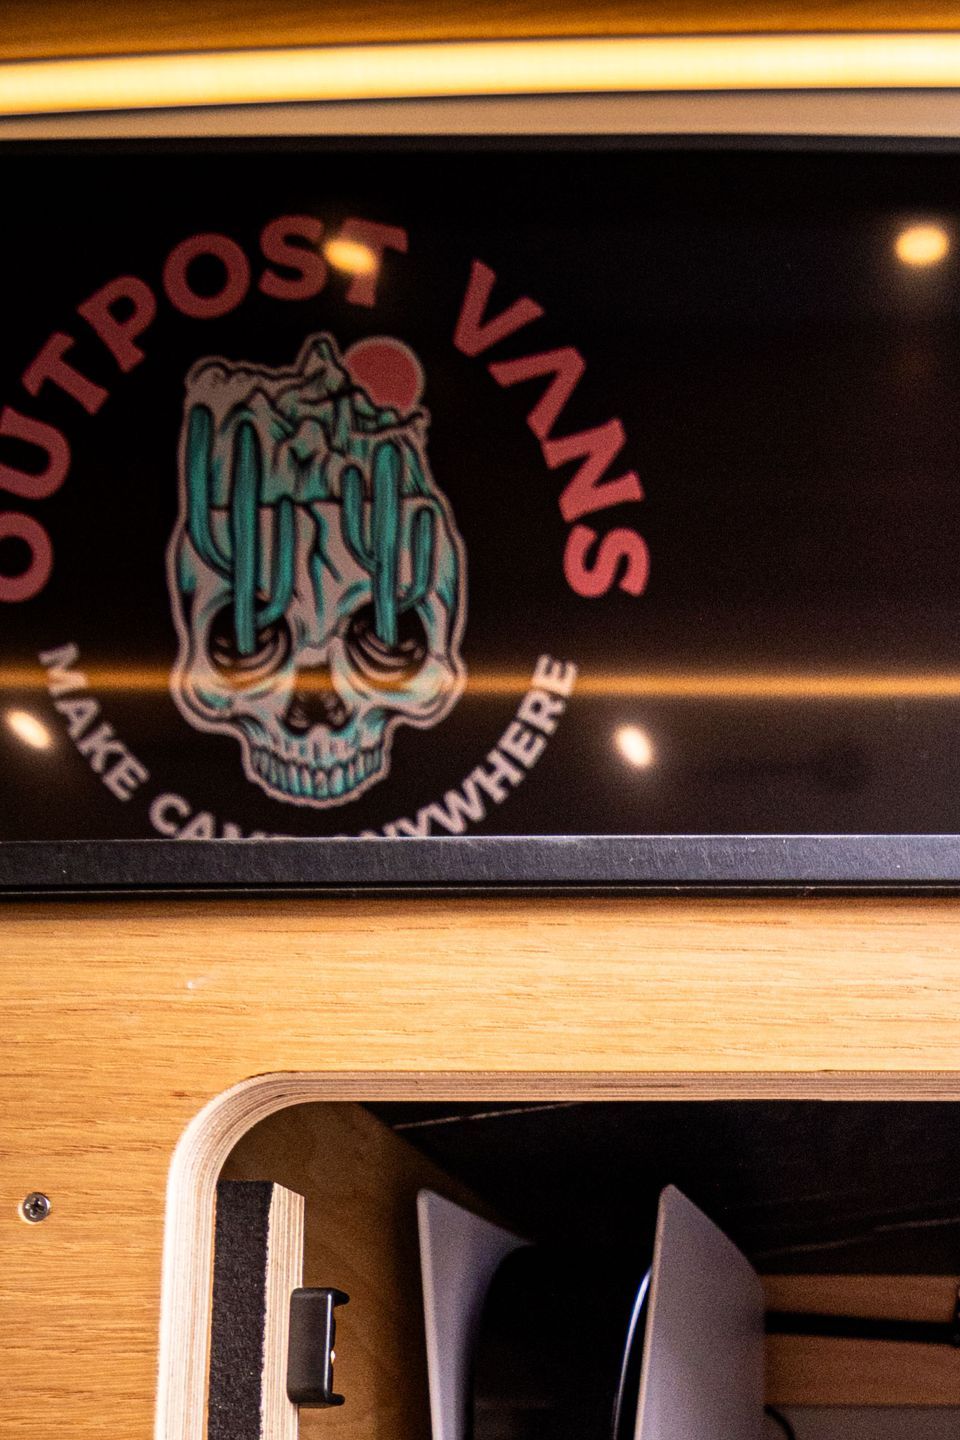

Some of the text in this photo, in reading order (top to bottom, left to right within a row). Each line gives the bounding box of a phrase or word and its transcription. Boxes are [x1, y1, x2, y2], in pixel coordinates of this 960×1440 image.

[453, 259, 651, 598] VANS
[39, 643, 578, 839] MAKE CA YWHERE
